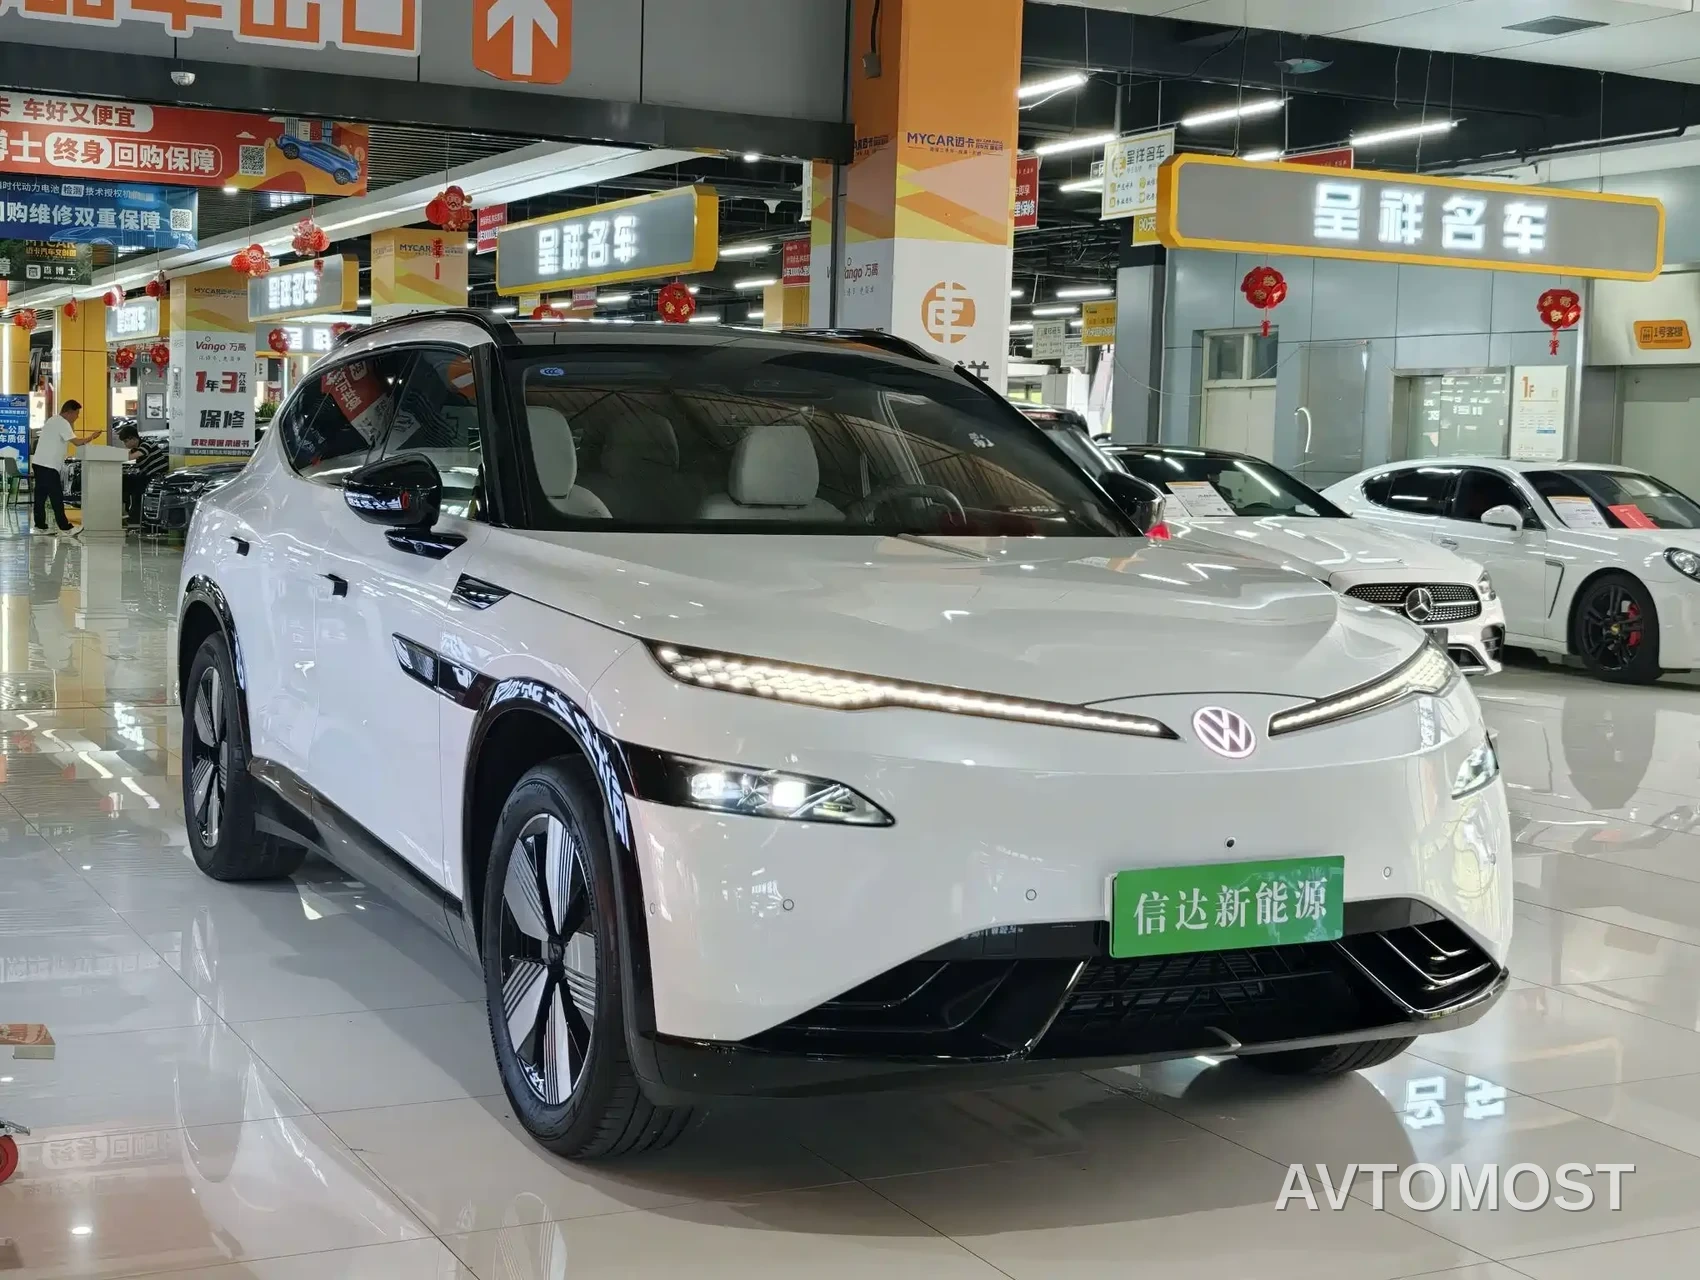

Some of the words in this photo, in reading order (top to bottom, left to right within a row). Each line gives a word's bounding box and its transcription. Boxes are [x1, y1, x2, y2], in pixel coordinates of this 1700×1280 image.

[22, 98, 136, 128] 车好又便宜
[53, 136, 104, 164] 终身
[113, 142, 215, 174] 回购保障
[0, 180, 60, 196] 时代动力电池
[0, 201, 161, 231] 购维修双重保障
[1313, 181, 1547, 254] 呈祥名车
[537, 215, 639, 276] 呈祥名车
[195, 341, 226, 353] Vango
[1522, 376, 1535, 398] 1F
[199, 409, 245, 429] 保修
[1133, 876, 1328, 936] 信达新能源
